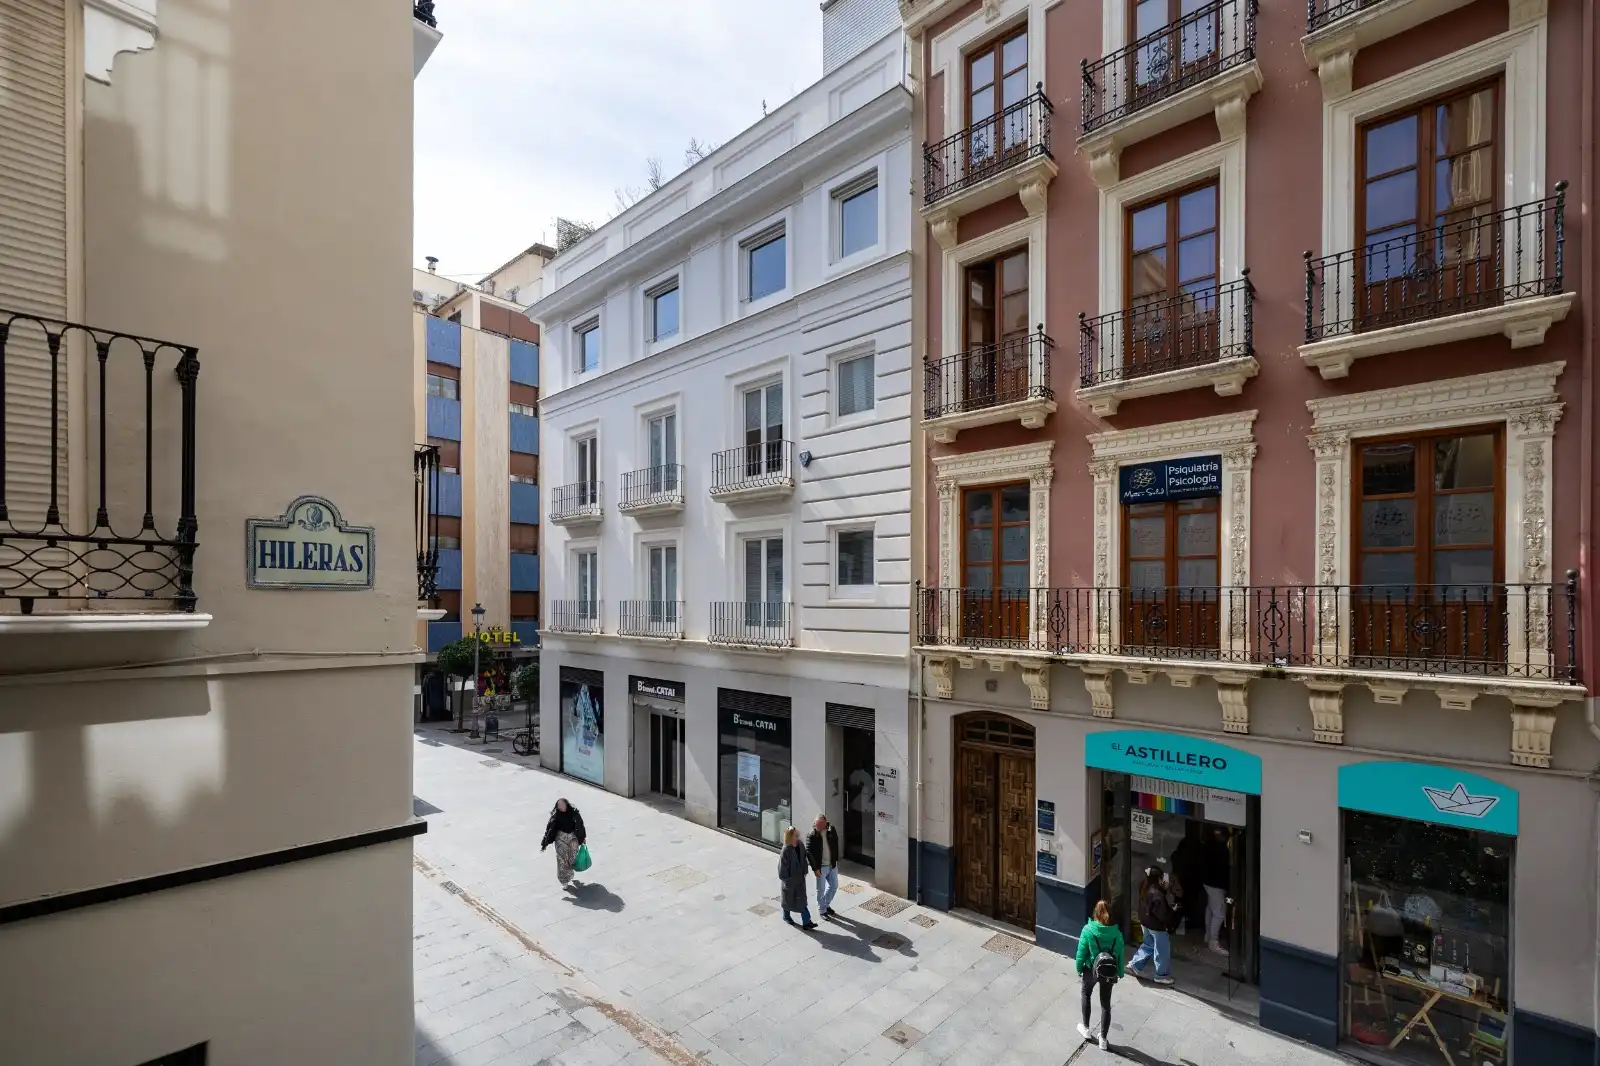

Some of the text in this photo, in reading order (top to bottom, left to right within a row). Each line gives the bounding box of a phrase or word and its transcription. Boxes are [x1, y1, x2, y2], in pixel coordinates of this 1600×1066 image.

[1168, 462, 1219, 476] Psiquiatría
[1169, 474, 1217, 487] Psicología
[258, 540, 364, 572] HILERAS
[1111, 742, 1122, 751] EL
[1125, 745, 1227, 770] ASTILLERO
[1132, 813, 1151, 825] ZBE
